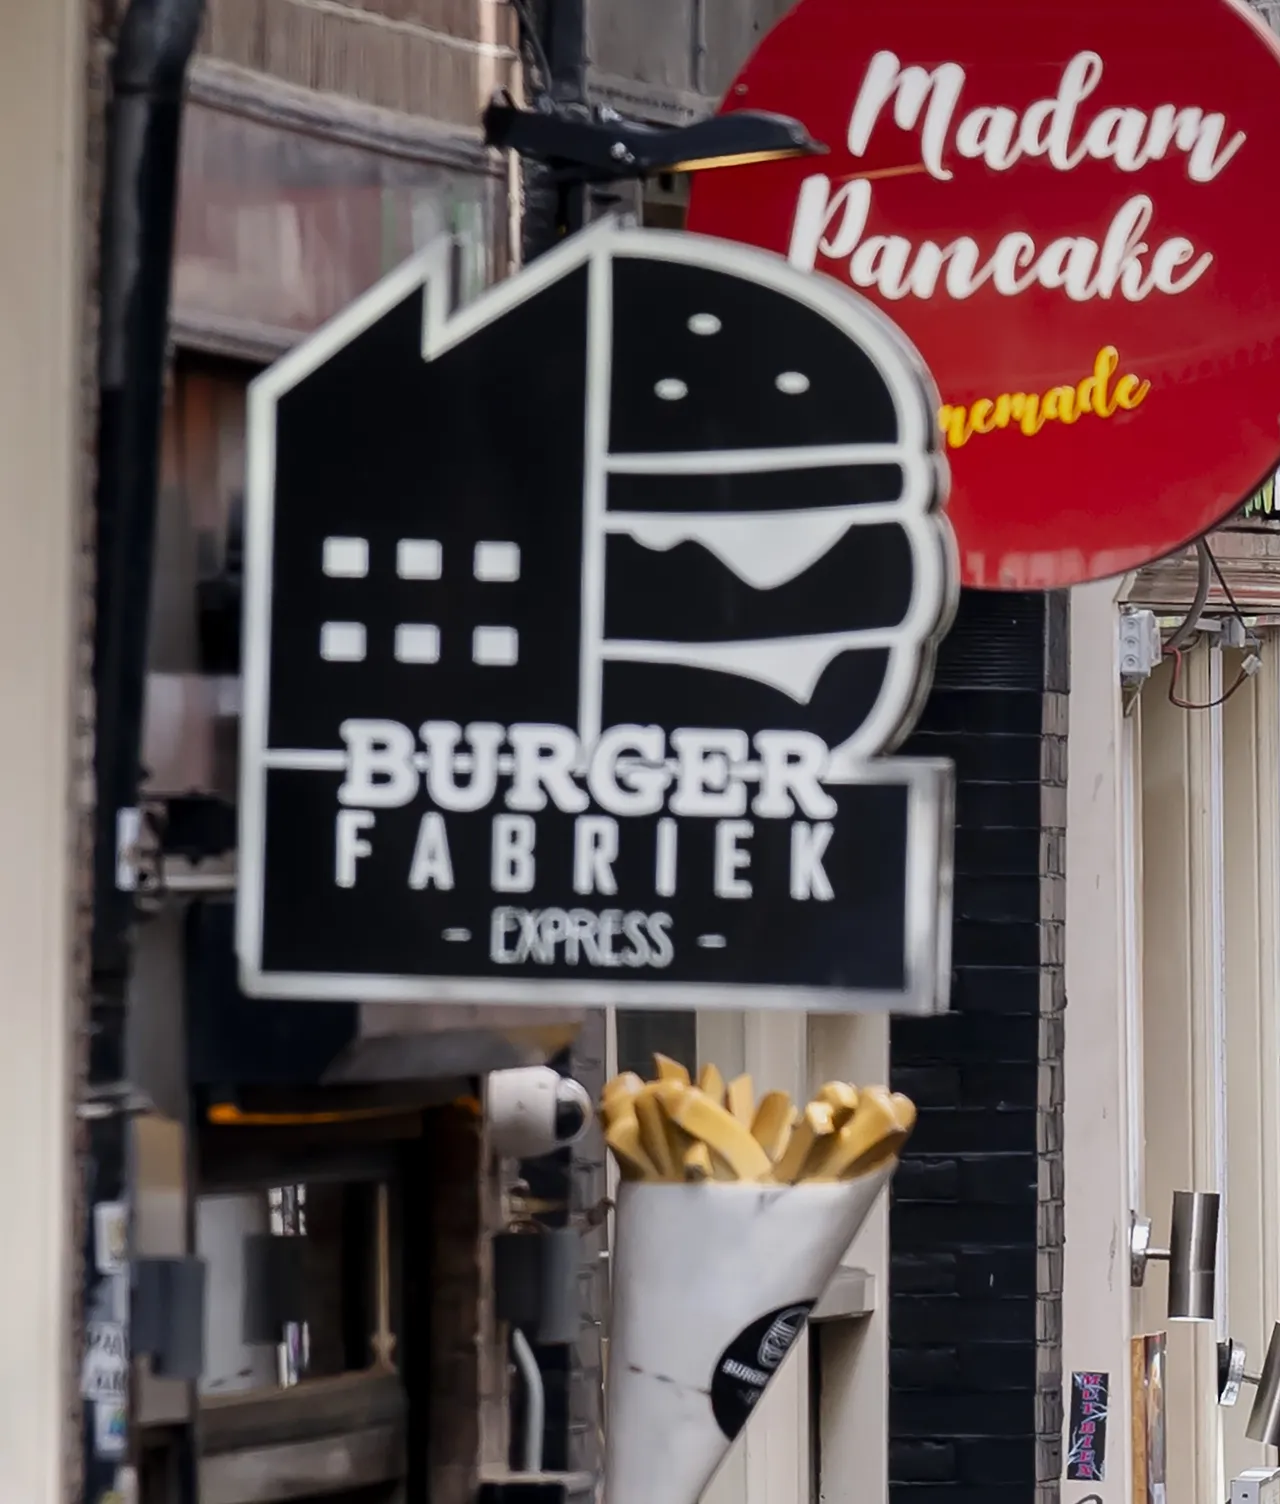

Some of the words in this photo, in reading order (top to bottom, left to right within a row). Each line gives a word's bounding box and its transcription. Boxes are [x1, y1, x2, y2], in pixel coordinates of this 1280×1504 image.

[847, 50, 1246, 182] Madam
[787, 173, 1213, 301] Pancake
[338, 718, 838, 819] BURGER
[335, 810, 834, 900] FABRIEK
[490, 906, 676, 967] EXPRESS
